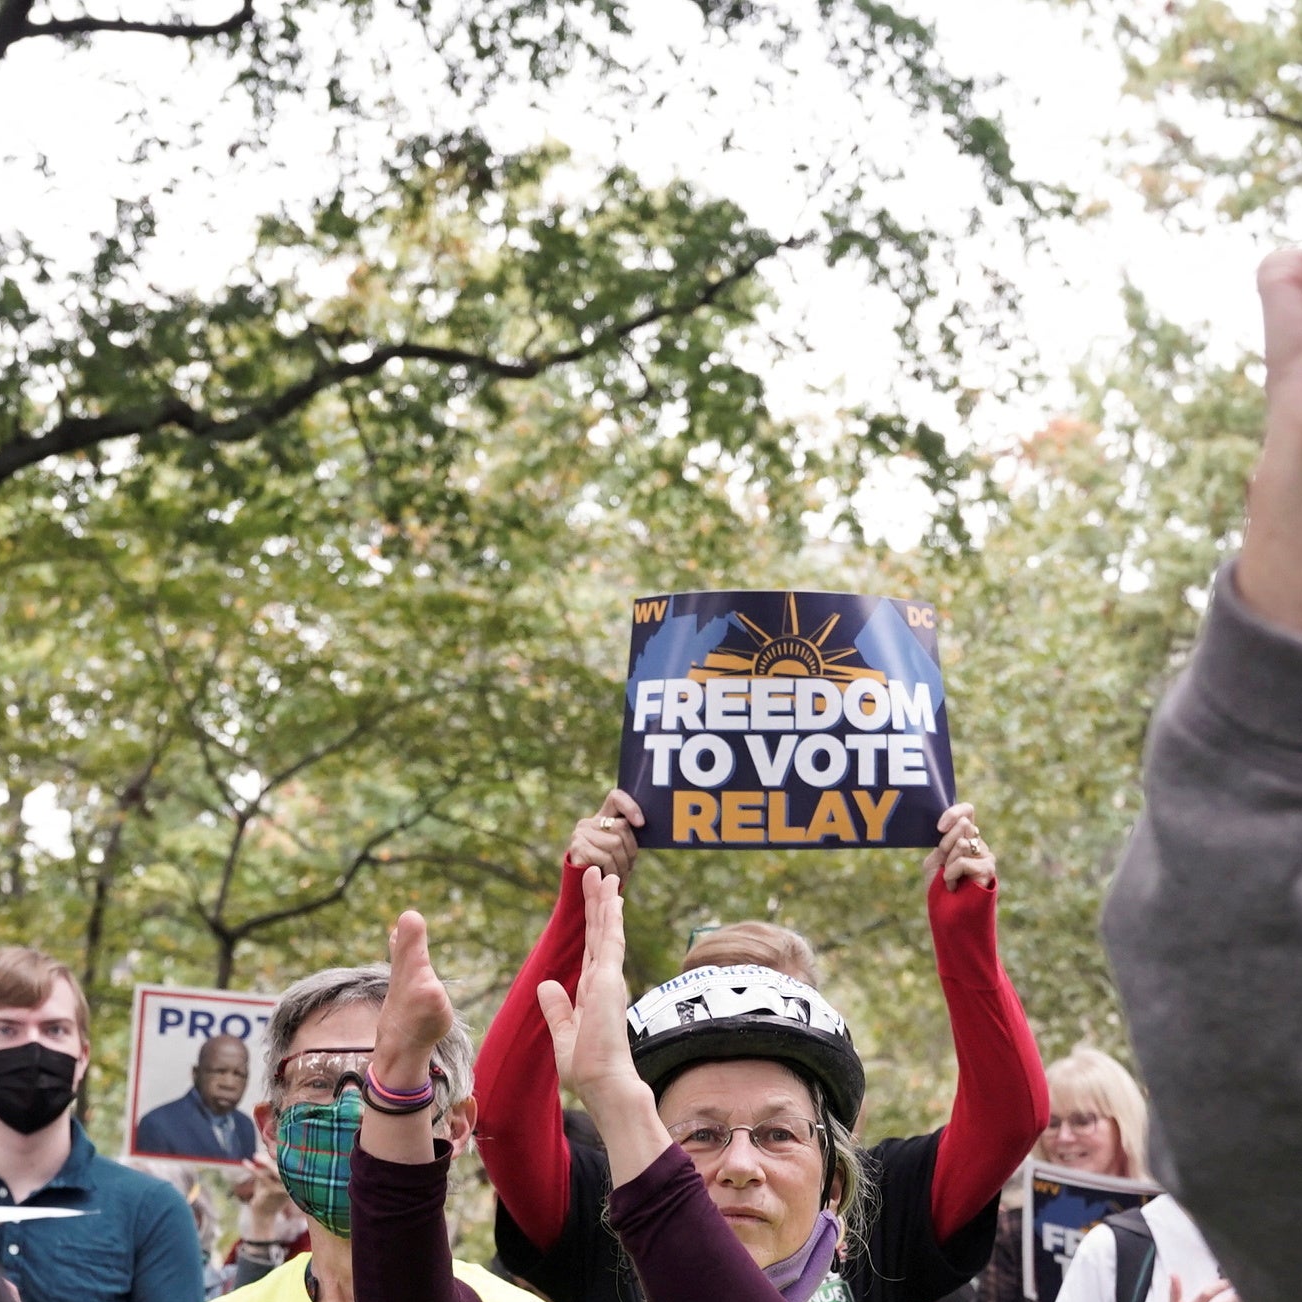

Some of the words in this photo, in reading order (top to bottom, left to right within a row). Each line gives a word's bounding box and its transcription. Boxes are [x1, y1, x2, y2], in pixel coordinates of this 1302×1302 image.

[634, 600, 667, 624] WV
[907, 606, 934, 629] DC
[633, 677, 937, 734] FREEDOM
[644, 734, 736, 788] TO
[744, 733, 930, 788] VOTE
[672, 790, 903, 843] RELAY
